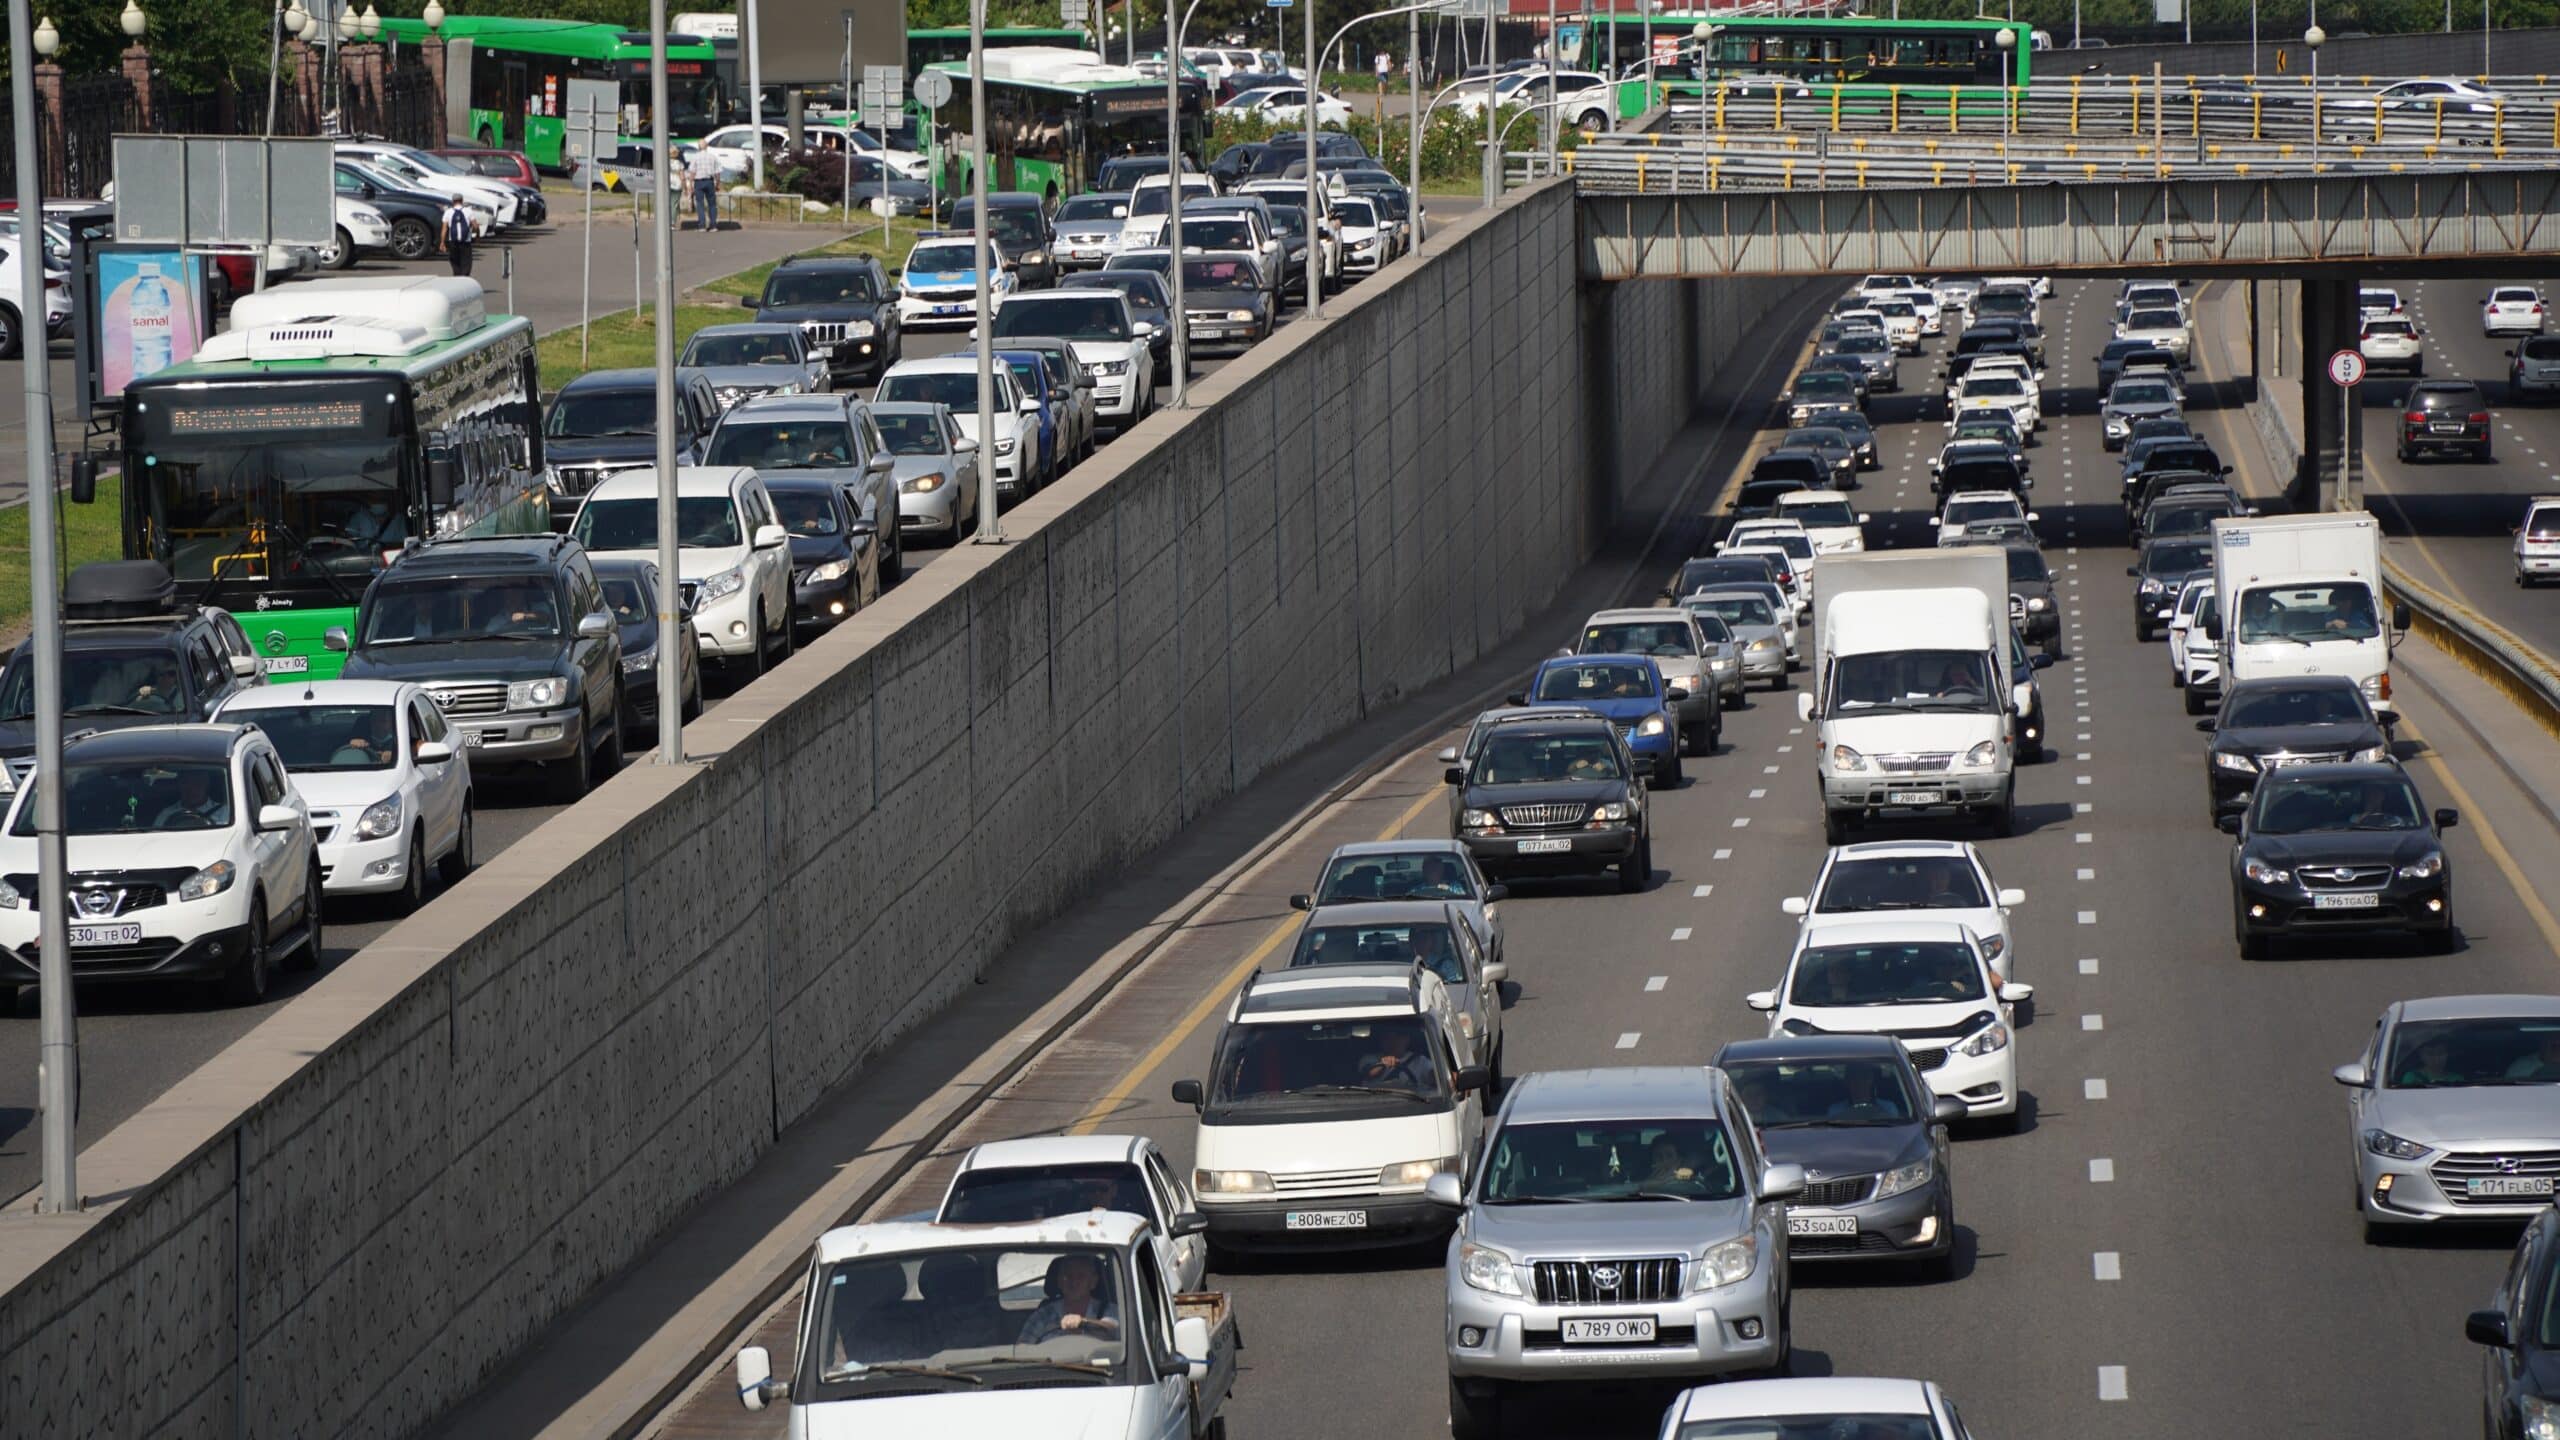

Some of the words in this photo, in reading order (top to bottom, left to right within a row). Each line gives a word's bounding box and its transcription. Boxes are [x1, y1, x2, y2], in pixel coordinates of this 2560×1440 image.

[132, 316, 168, 326] samal
[2343, 359, 2352, 371] 5
[294, 658, 306, 667] 02
[466, 735, 481, 746] 02
[2364, 895, 2377, 905] 02
[122, 926, 138, 940] 02
[2481, 1180, 2505, 1192] 171
[2508, 1182, 2532, 1192] FLB
[2534, 1179, 2551, 1192] 05
[1298, 1213, 1322, 1226] 808
[1348, 1212, 1365, 1225] 05
[1788, 1219, 1809, 1232] 153
[1838, 1218, 1855, 1232] 02
[1567, 1322, 1578, 1337] A
[1583, 1321, 1611, 1337] 789
[1616, 1321, 1651, 1336] OWO
